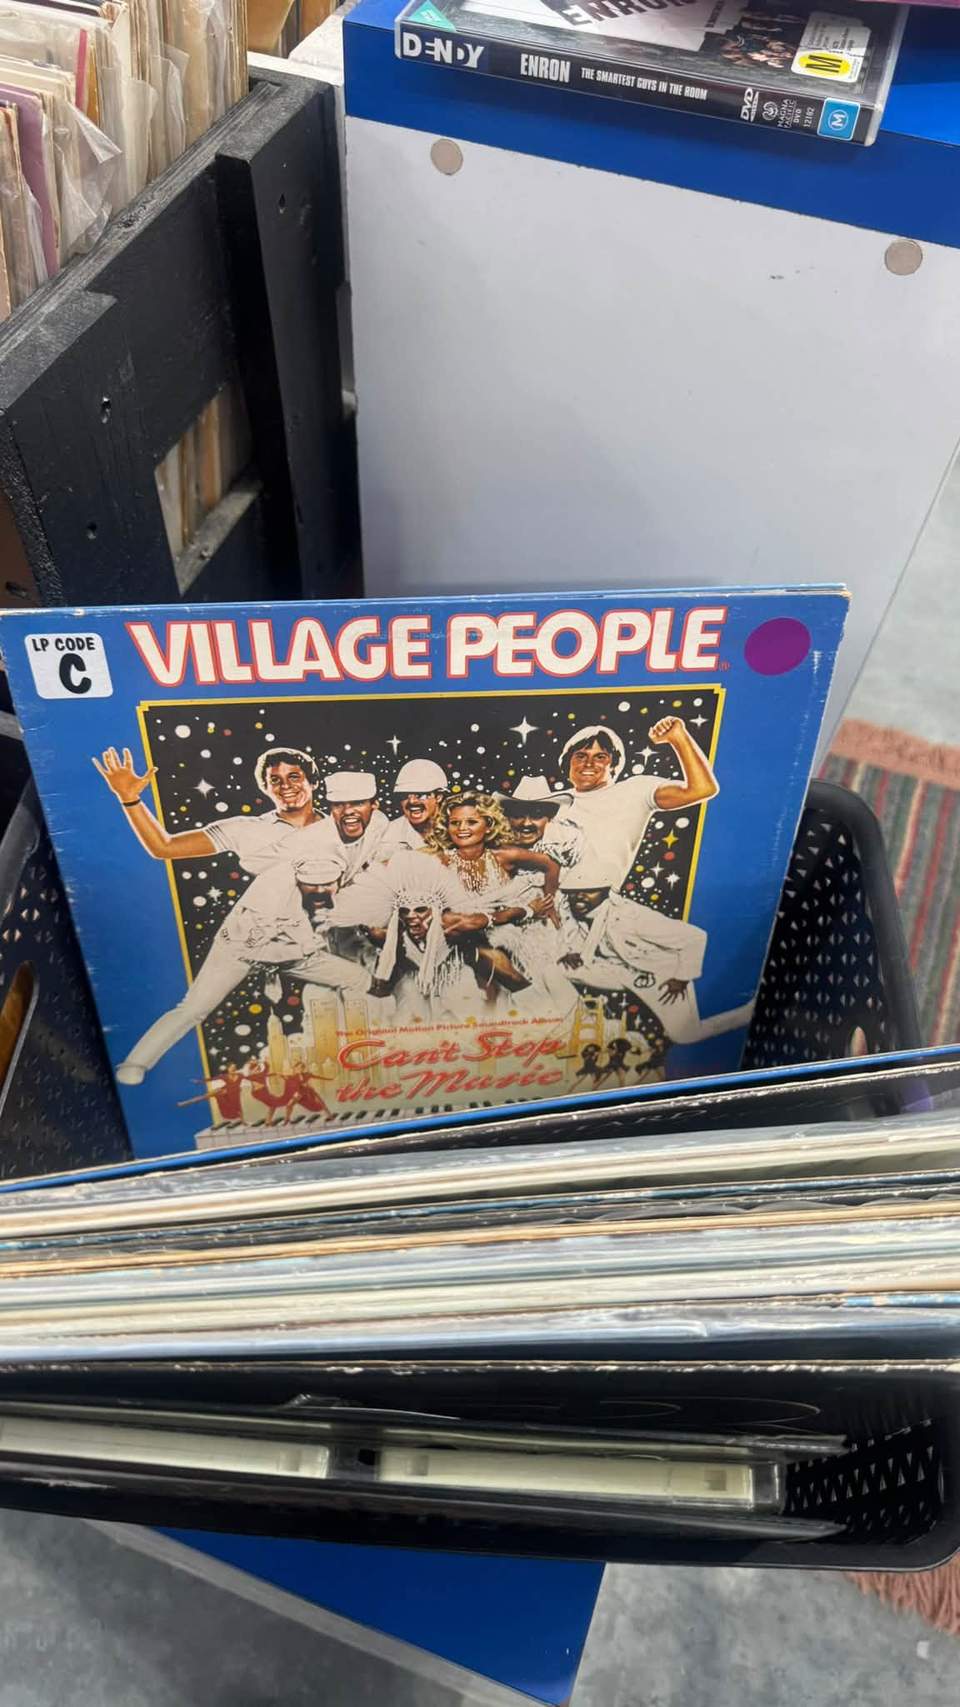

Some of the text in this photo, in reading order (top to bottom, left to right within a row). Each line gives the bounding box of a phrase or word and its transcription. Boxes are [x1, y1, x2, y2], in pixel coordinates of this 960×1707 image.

[402, 32, 484, 69] DENDY
[520, 53, 572, 83] ENRON
[581, 67, 708, 100] THE SMARTEST GUYS IN THE ROOM
[740, 87, 754, 121] DVD
[793, 108, 802, 124] DVD
[831, 112, 846, 128] M
[32, 637, 96, 652] LP CODE
[124, 606, 728, 687] VILLAGE PEOPLE
[59, 653, 92, 694] C
[355, 1028, 398, 1037] Original
[399, 1025, 434, 1033] Motion
[436, 1023, 470, 1031] Picture
[472, 1019, 529, 1029] Soundtrack
[531, 1016, 565, 1025] Album
[462, 1030, 565, 1068] Stop
[336, 1063, 563, 1103] the Music
